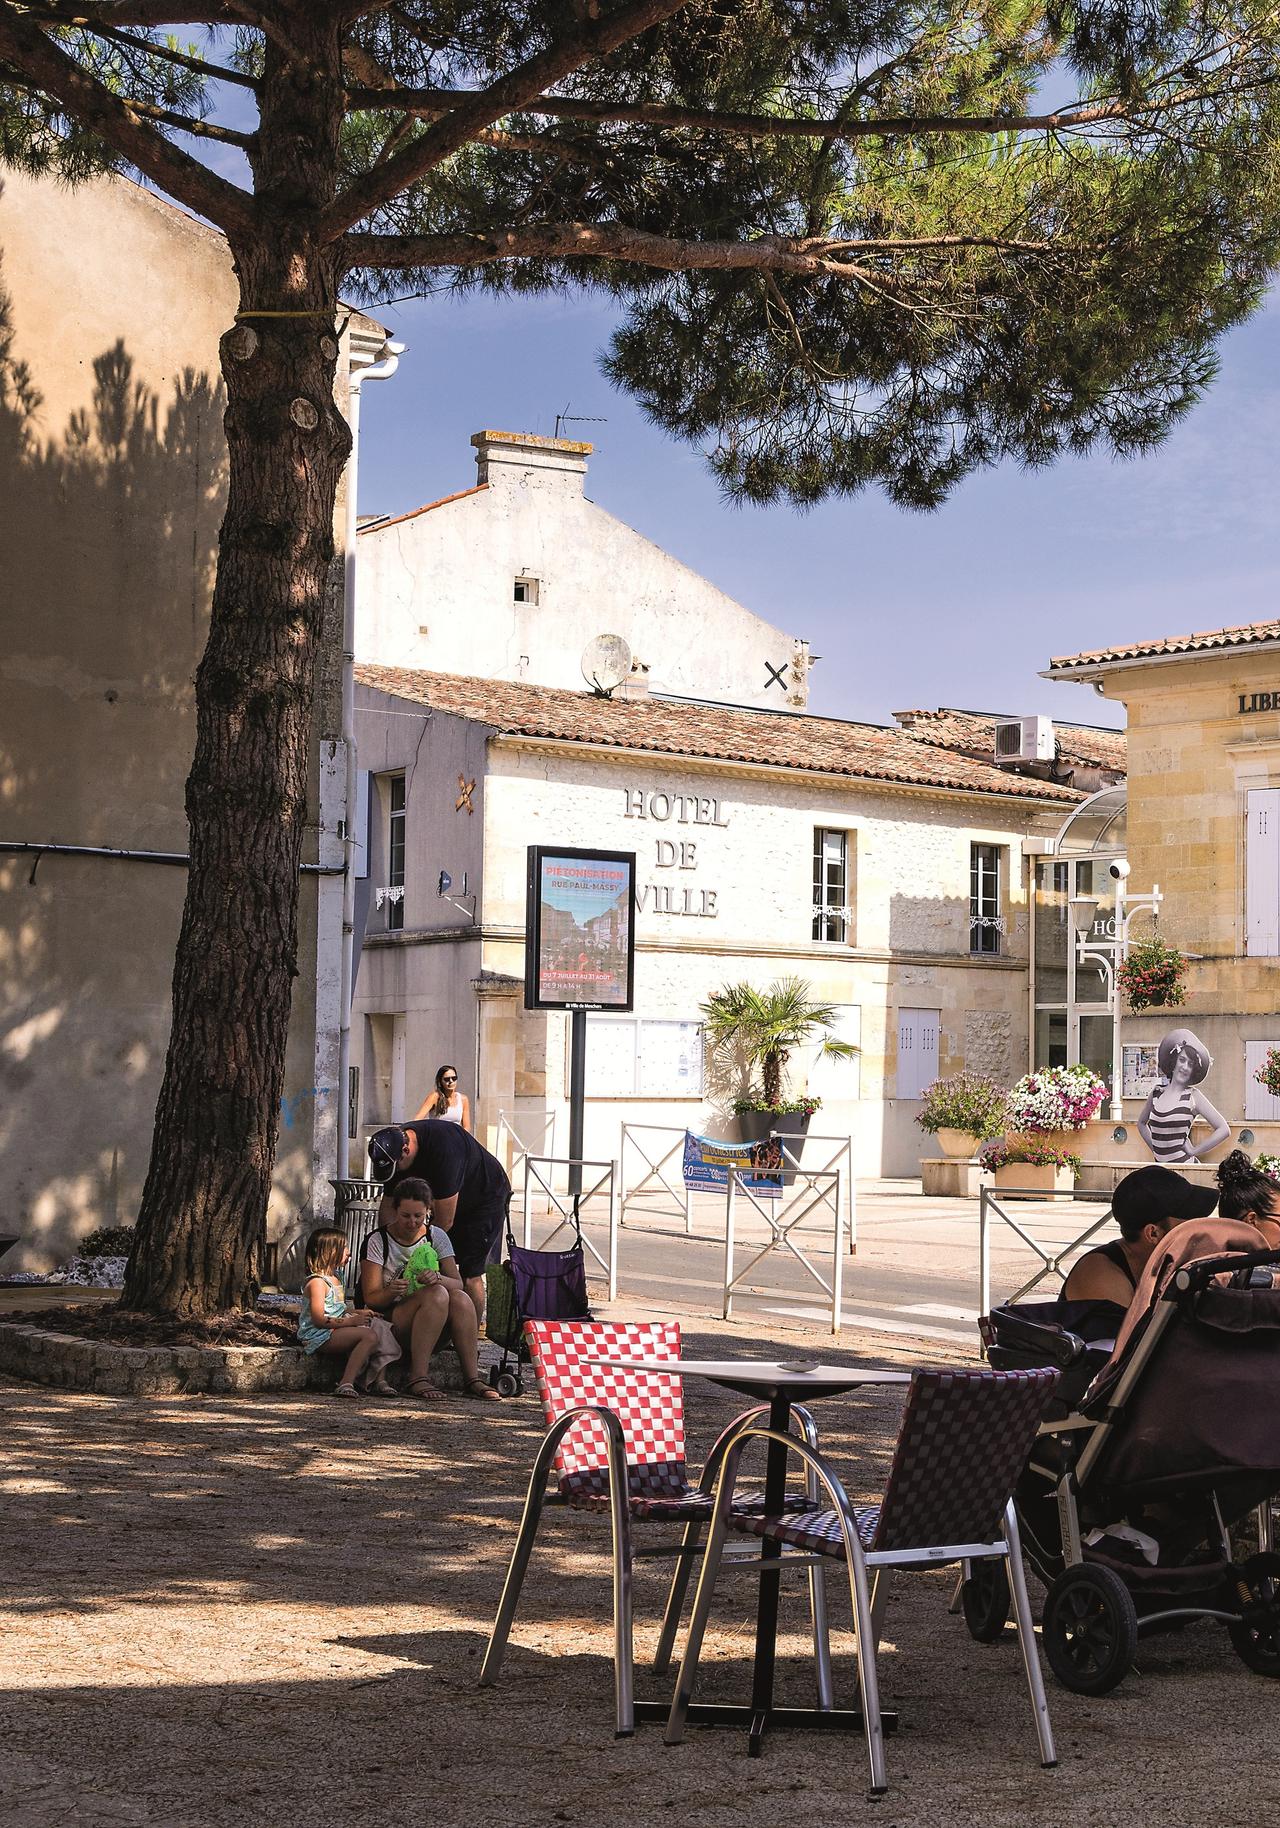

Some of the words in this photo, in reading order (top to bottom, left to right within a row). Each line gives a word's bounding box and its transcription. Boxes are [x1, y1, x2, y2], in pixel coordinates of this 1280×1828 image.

[655, 839, 698, 870] DE
[552, 881, 568, 889] RUE
[635, 884, 719, 918] VILLE
